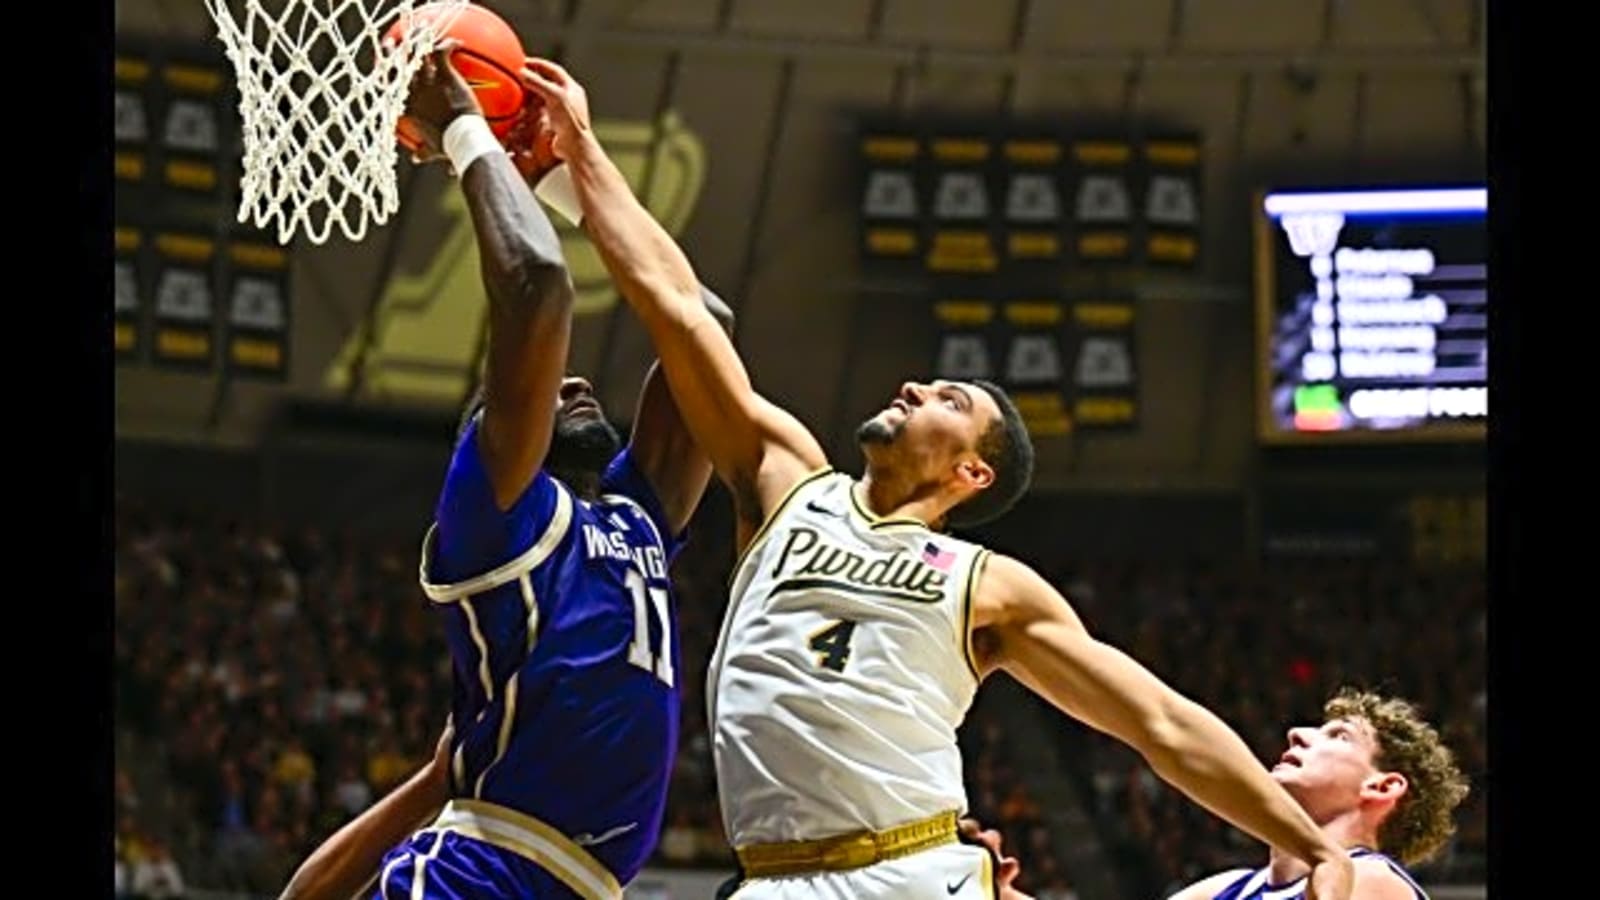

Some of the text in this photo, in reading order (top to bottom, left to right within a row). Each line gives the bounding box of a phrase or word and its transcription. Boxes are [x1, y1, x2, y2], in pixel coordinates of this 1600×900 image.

[771, 527, 948, 600] Purdue
[624, 566, 675, 688] 11
[808, 617, 857, 674] 4
